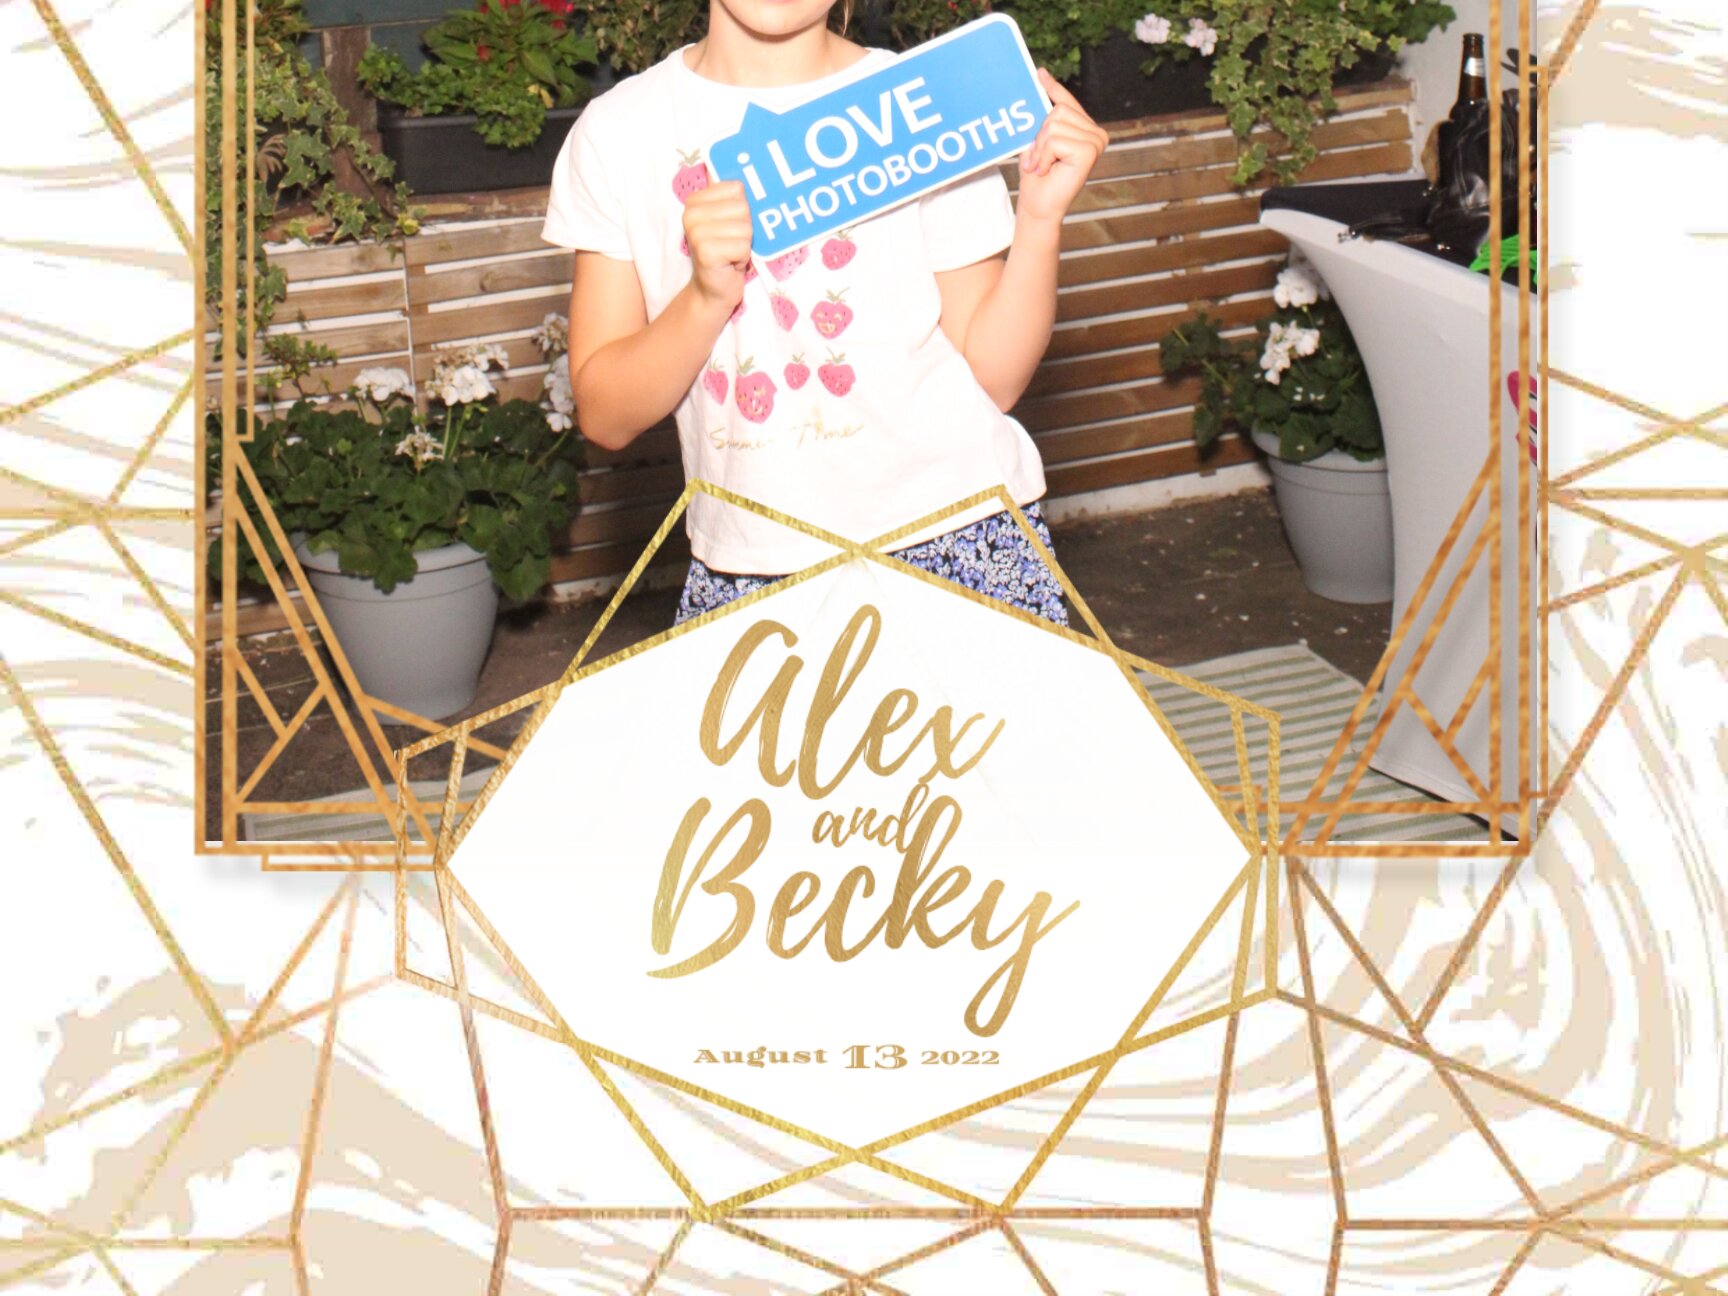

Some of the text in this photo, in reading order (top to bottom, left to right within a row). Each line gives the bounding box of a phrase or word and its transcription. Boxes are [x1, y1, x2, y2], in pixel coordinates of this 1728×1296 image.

[737, 76, 943, 201] i LOVE
[757, 99, 1036, 241] PHOTOBOOTHS
